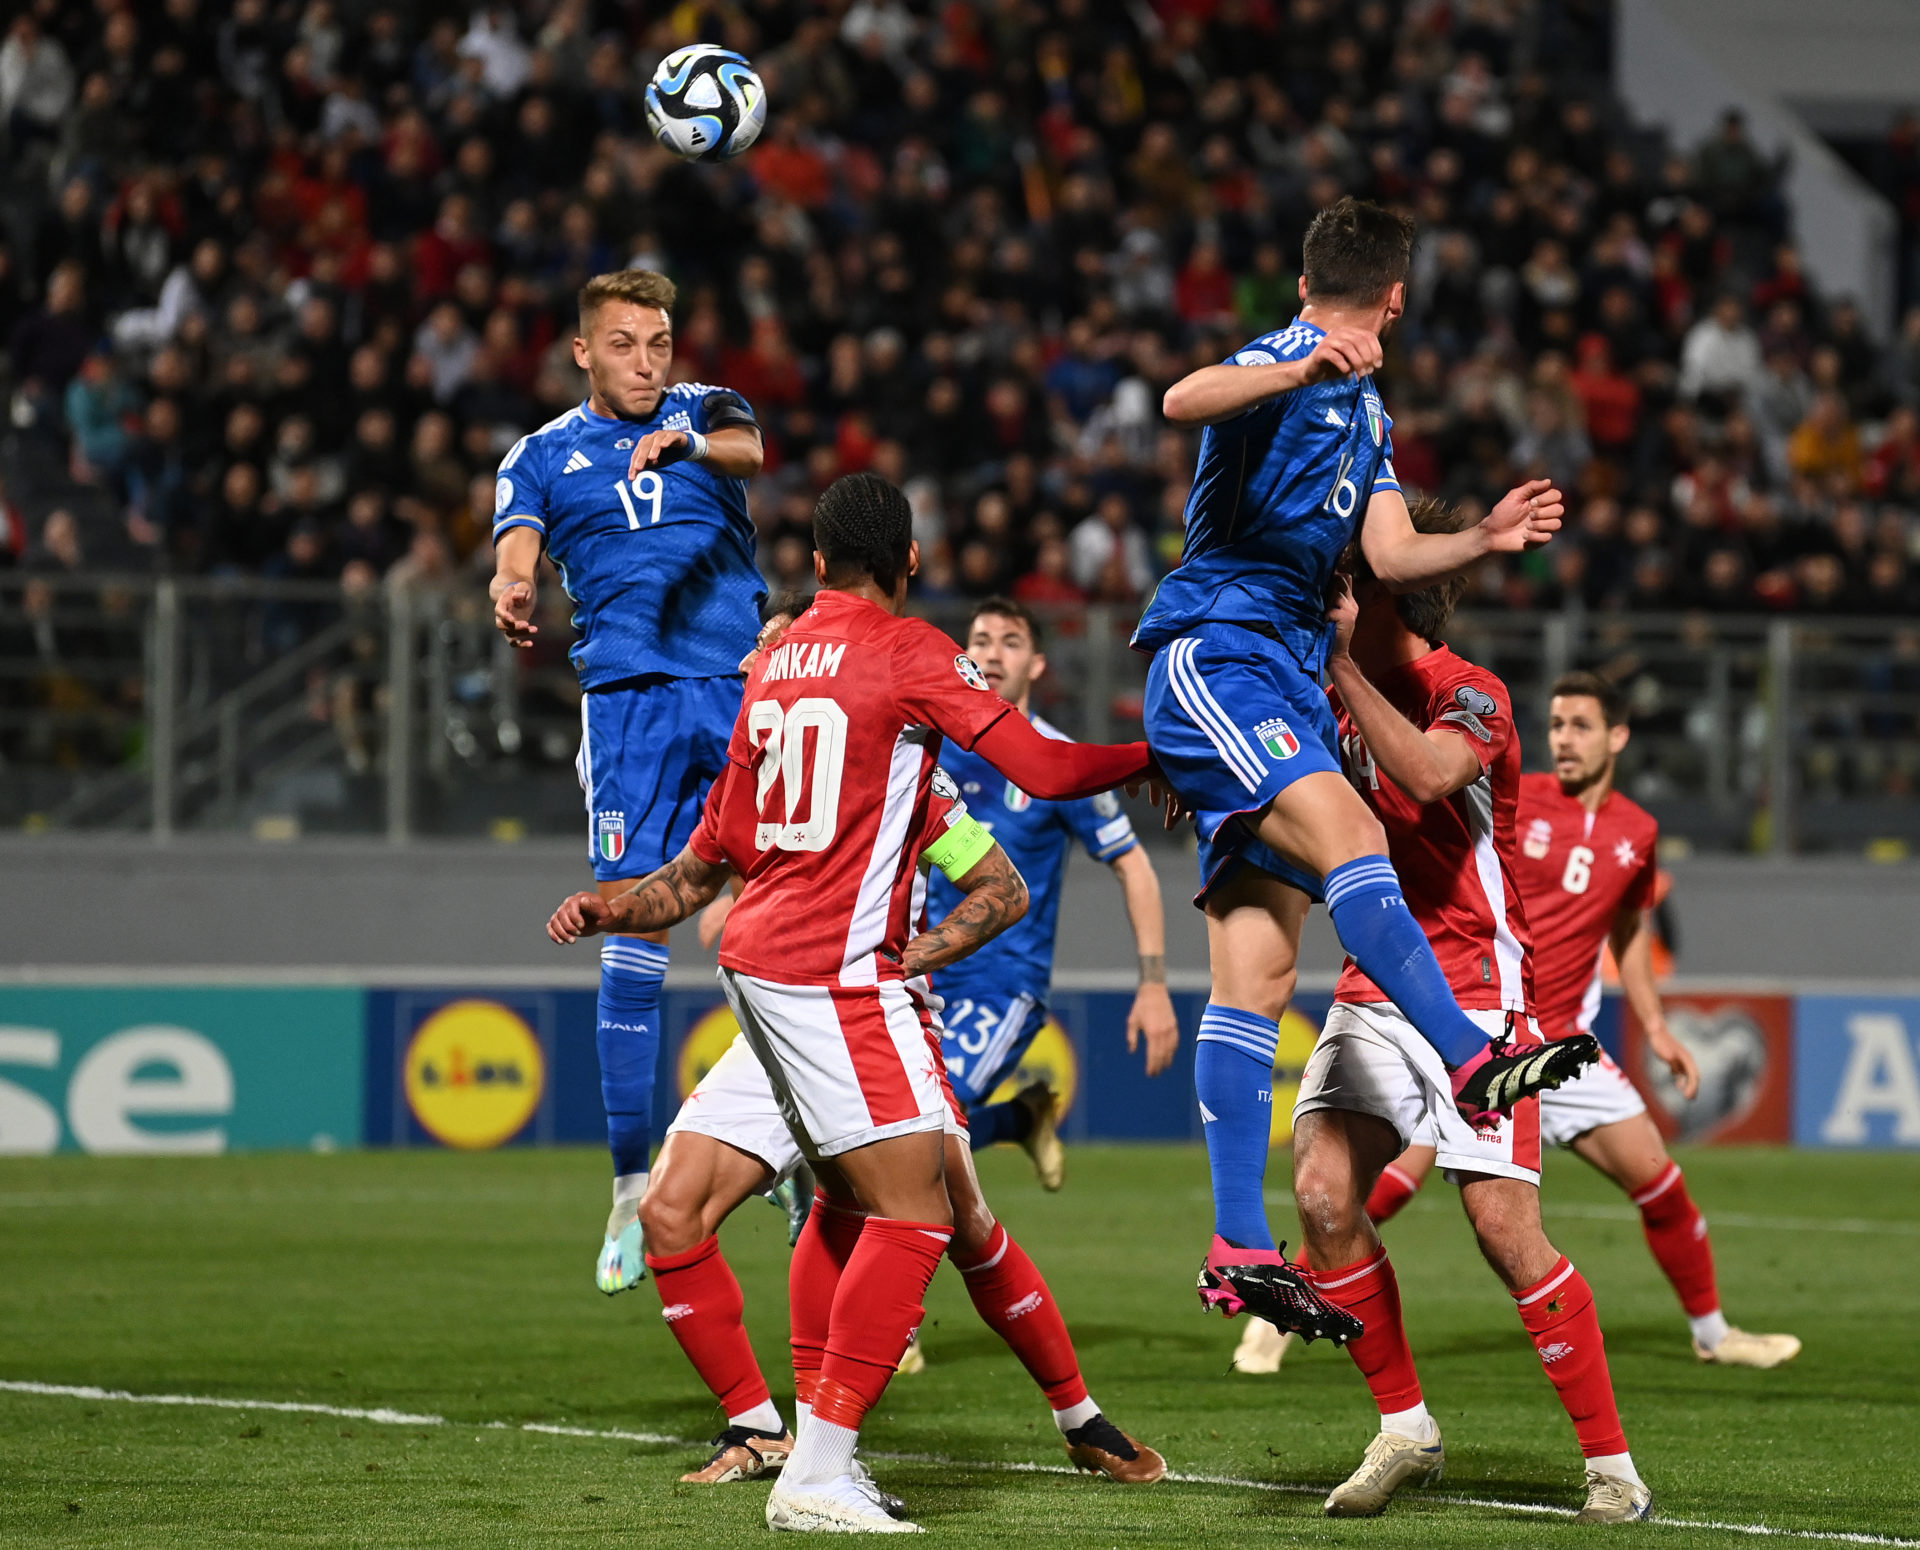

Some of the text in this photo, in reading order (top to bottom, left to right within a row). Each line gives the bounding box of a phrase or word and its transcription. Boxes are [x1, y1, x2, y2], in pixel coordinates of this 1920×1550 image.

[614, 470, 664, 531] 19
[1323, 452, 1357, 518] 16
[748, 697, 849, 852] 20
[600, 821, 621, 831] ITALIA
[1561, 845, 1595, 895] 6
[601, 1020, 649, 1033] ITALIA
[943, 998, 1000, 1055] 23
